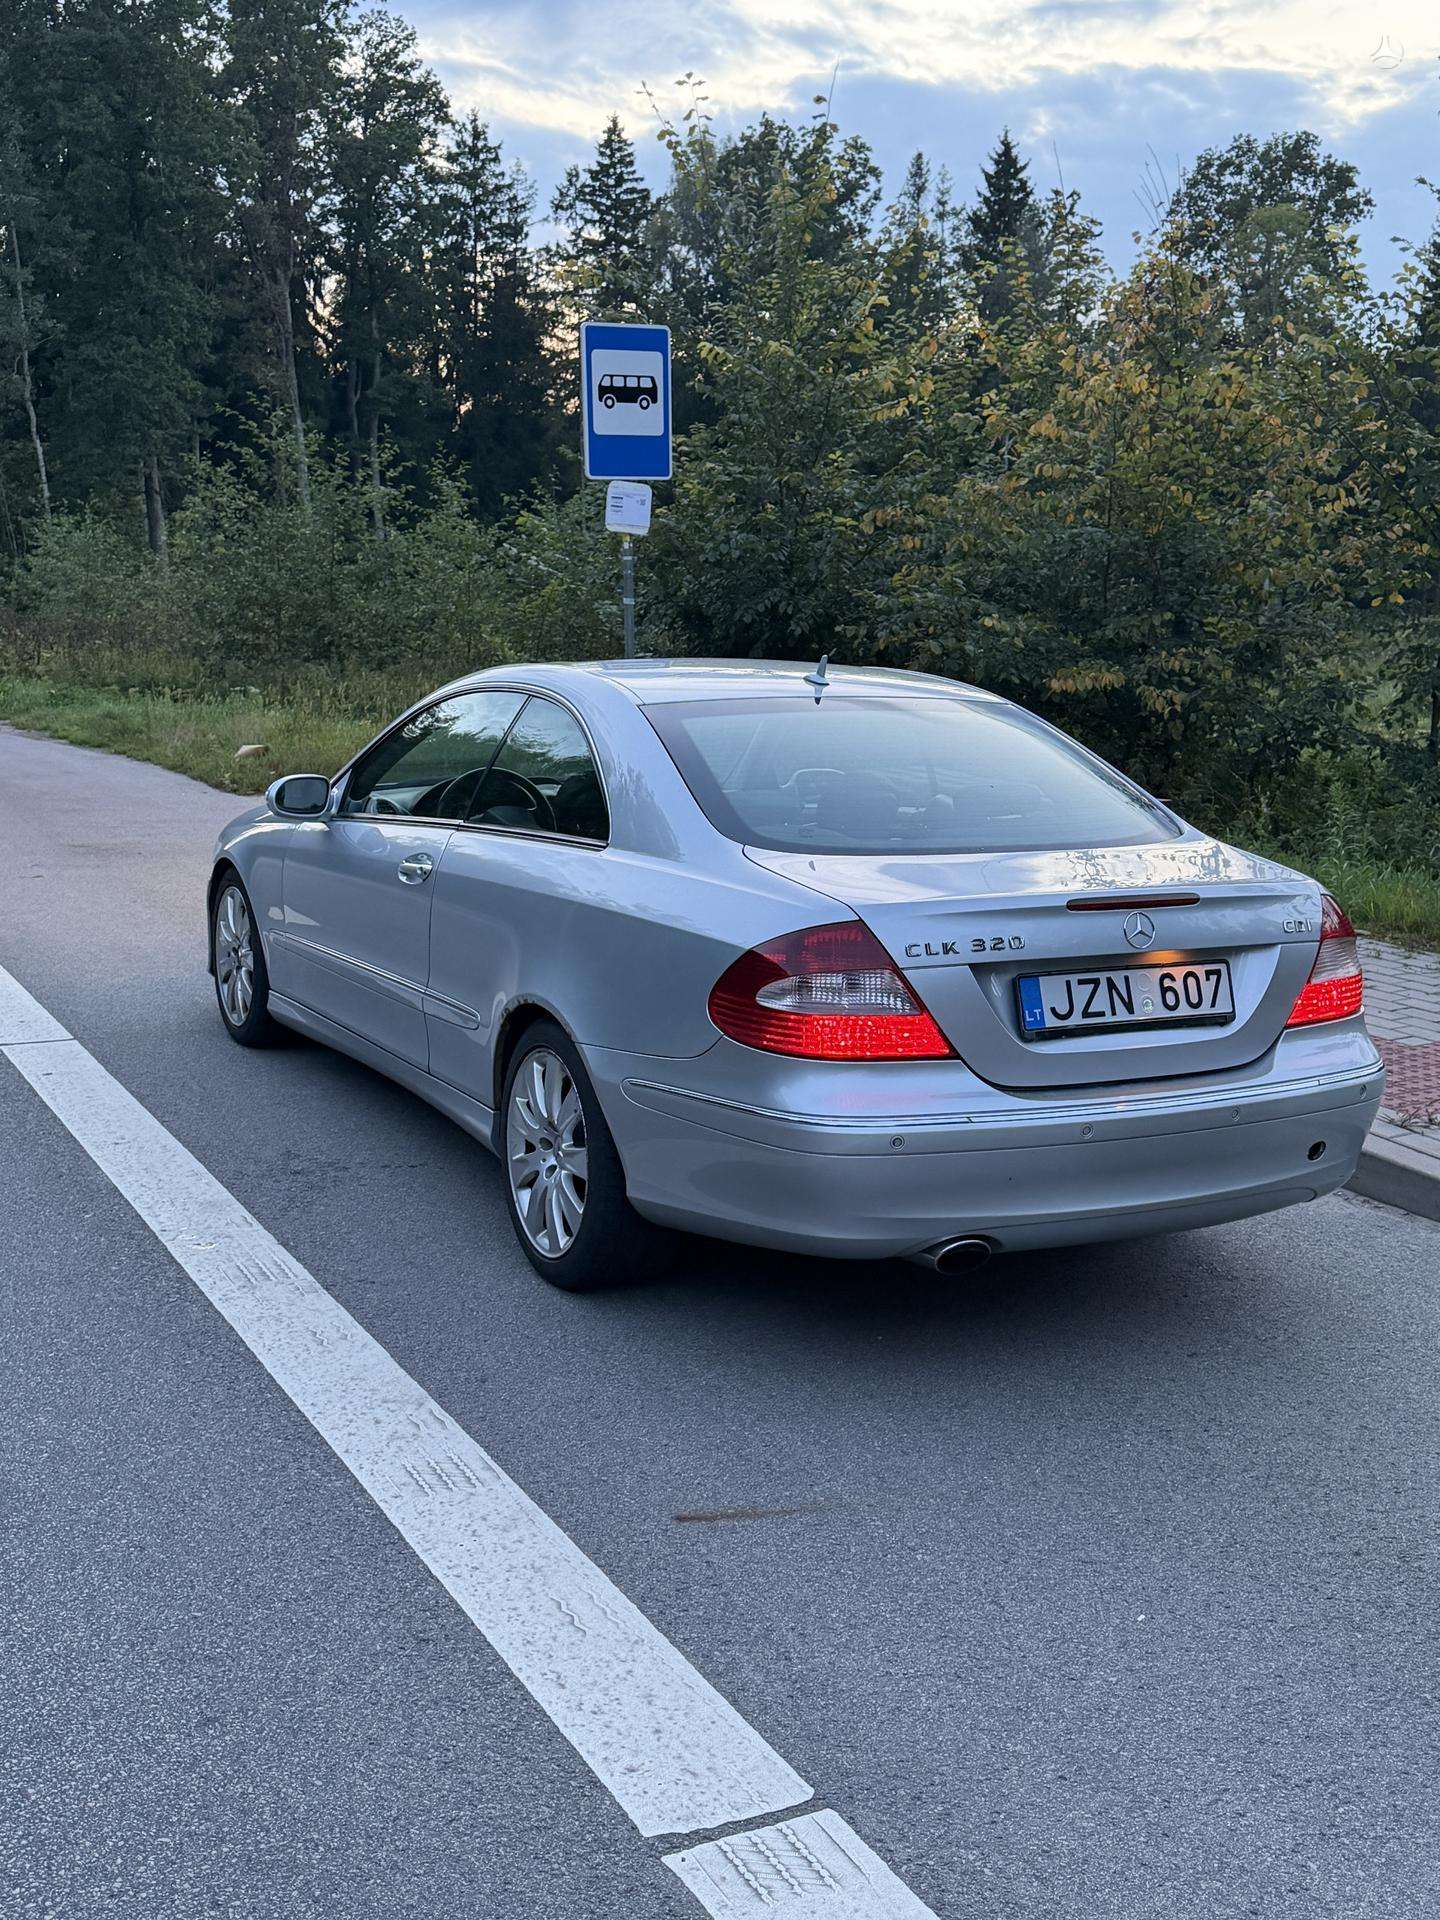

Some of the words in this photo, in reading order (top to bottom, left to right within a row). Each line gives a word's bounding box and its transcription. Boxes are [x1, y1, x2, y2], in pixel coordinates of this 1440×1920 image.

[1283, 918, 1312, 933] CDI
[905, 941, 960, 957] CLK
[971, 935, 1026, 953] 320
[1050, 975, 1135, 1020] JZN
[1159, 968, 1222, 1011] 607
[1025, 1008, 1042, 1021] LT
